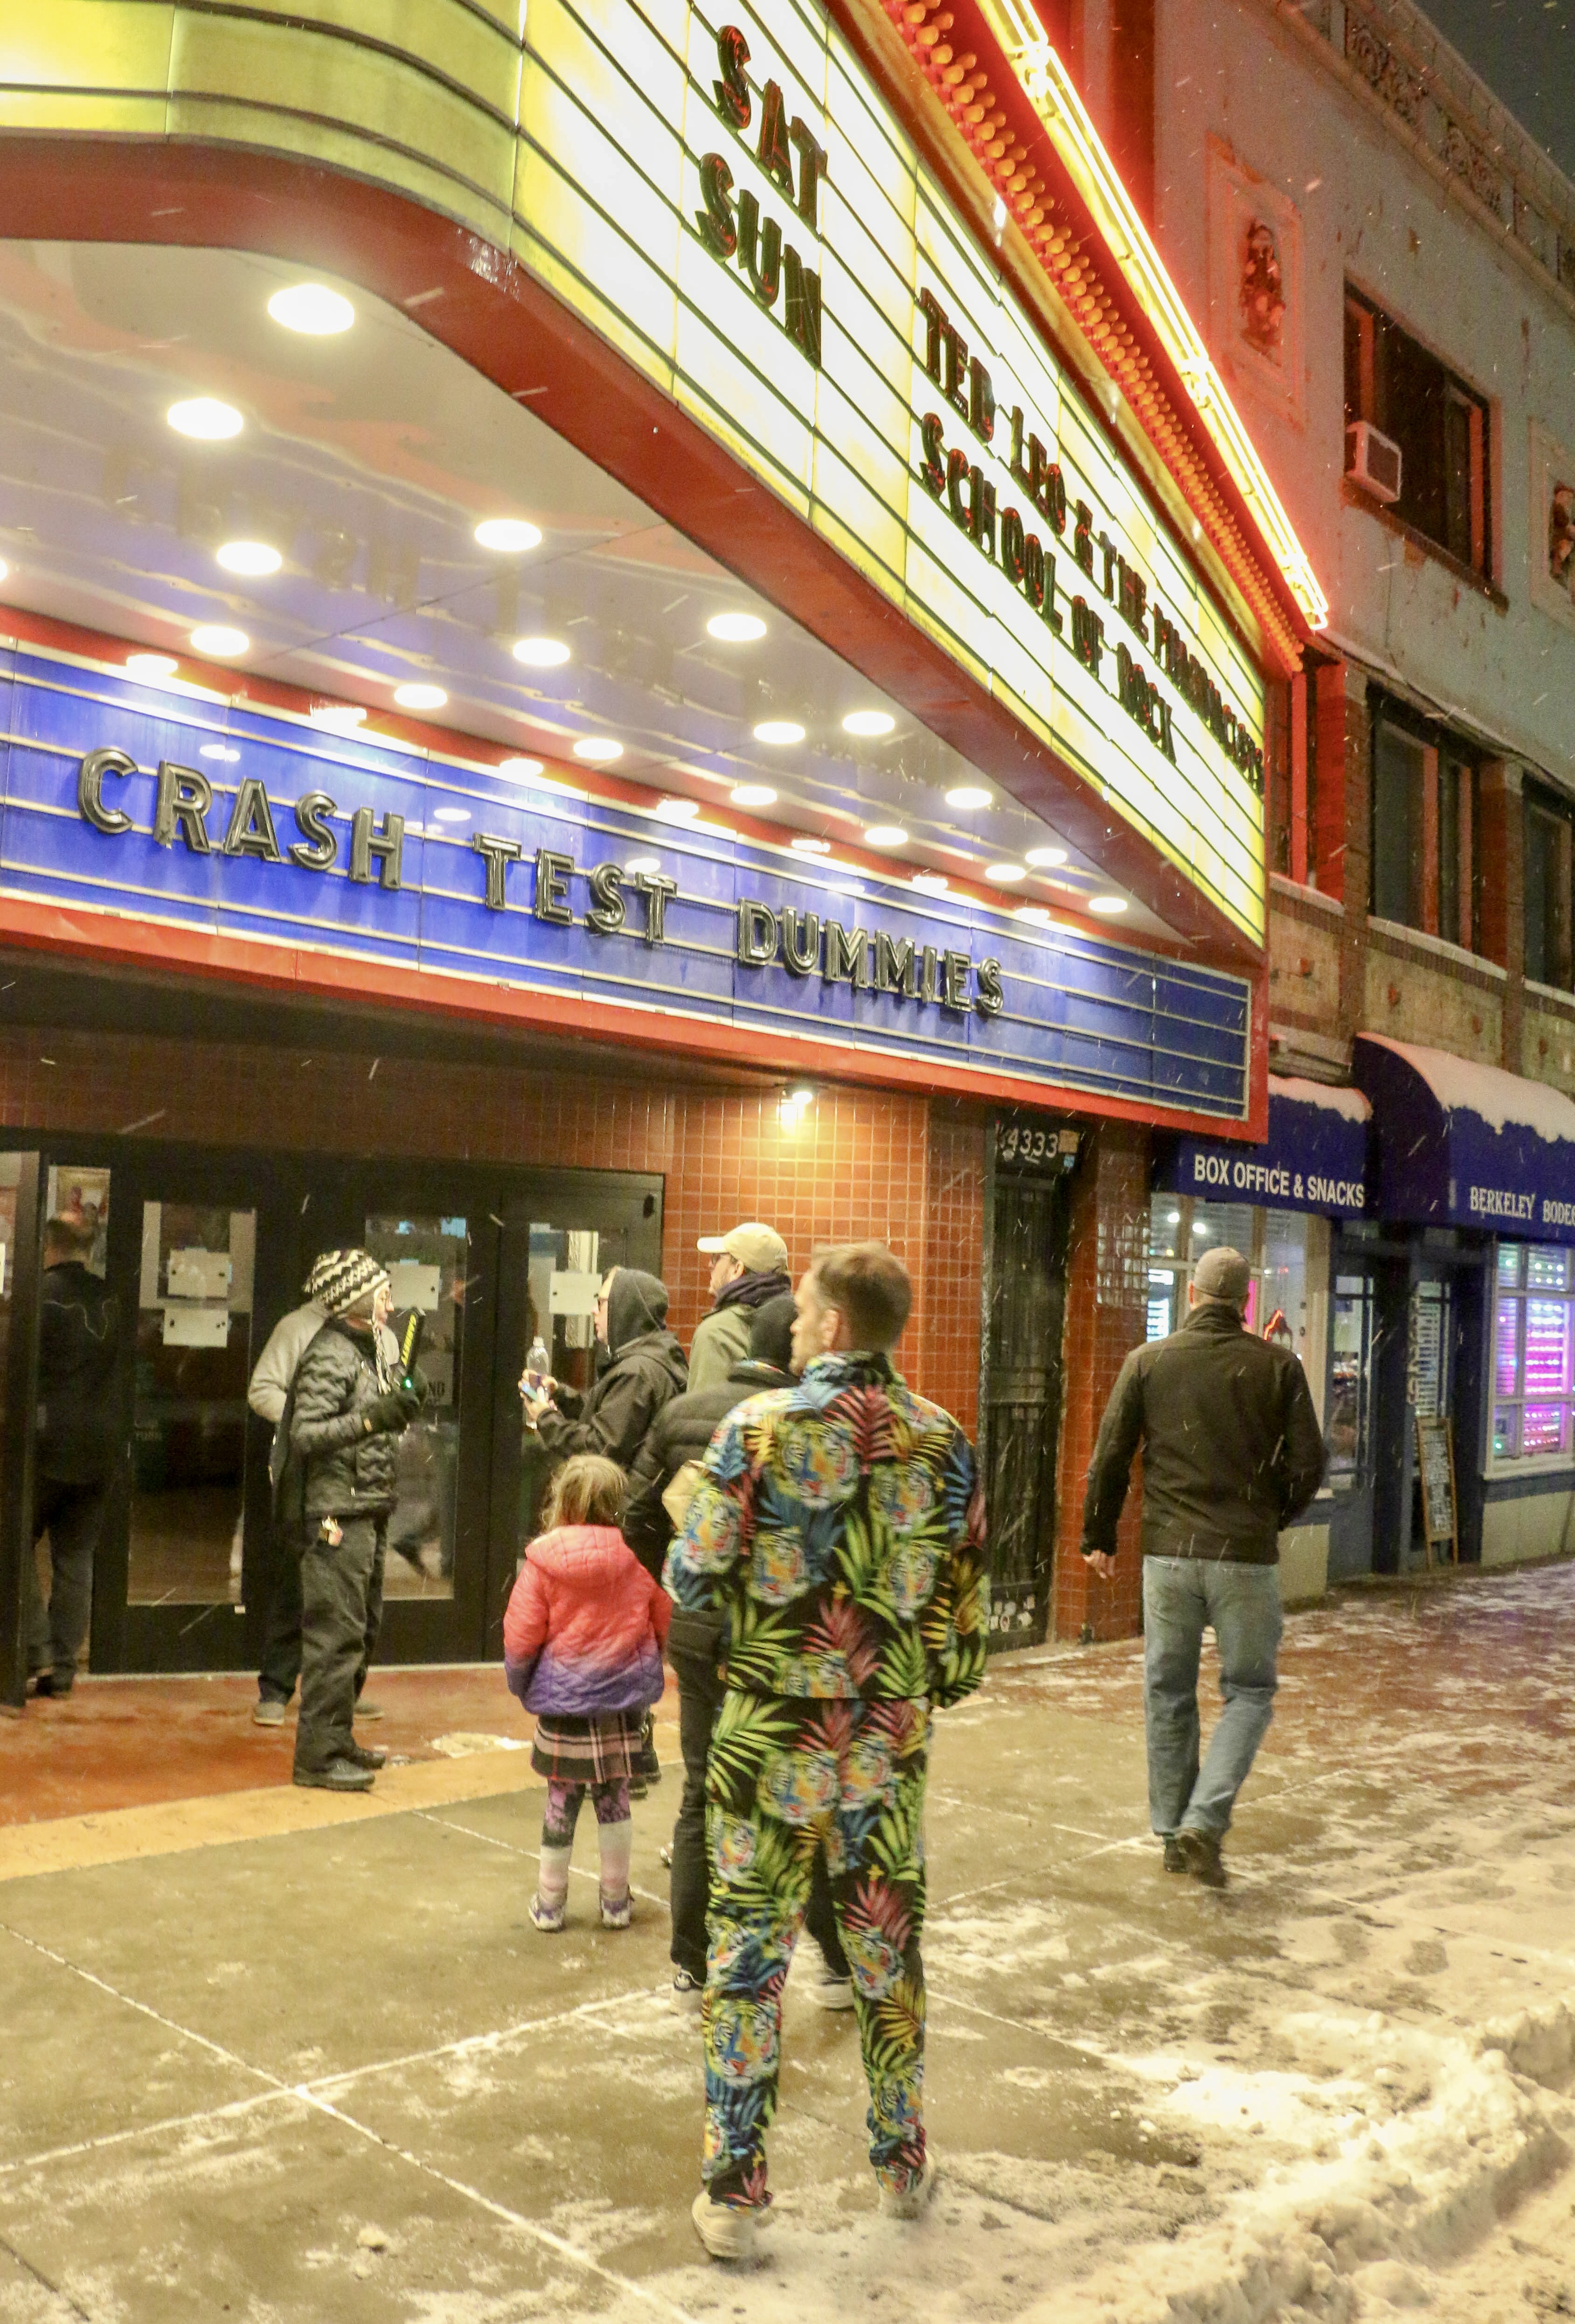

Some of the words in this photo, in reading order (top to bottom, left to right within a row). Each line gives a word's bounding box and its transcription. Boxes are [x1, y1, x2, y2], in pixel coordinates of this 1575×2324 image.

[695, 153, 821, 369] SUN
[919, 412, 1062, 636] SCHOOL
[1071, 595, 1104, 680] OF
[1117, 641, 1177, 765] ROCK
[713, 25, 827, 232] SAT
[919, 287, 995, 442] TED
[1010, 405, 1066, 535] LEO
[1098, 530, 1149, 643] THE
[77, 746, 404, 890] CRASH
[472, 833, 677, 943] TEST
[737, 898, 1004, 1015] DUMMIES
[1194, 1154, 1230, 1186] BOX
[1233, 1161, 1290, 1196] OFFICE
[1293, 1174, 1304, 1199] &
[1307, 1175, 1366, 1208] SNACKS
[1470, 1186, 1536, 1220] BERKELEY
